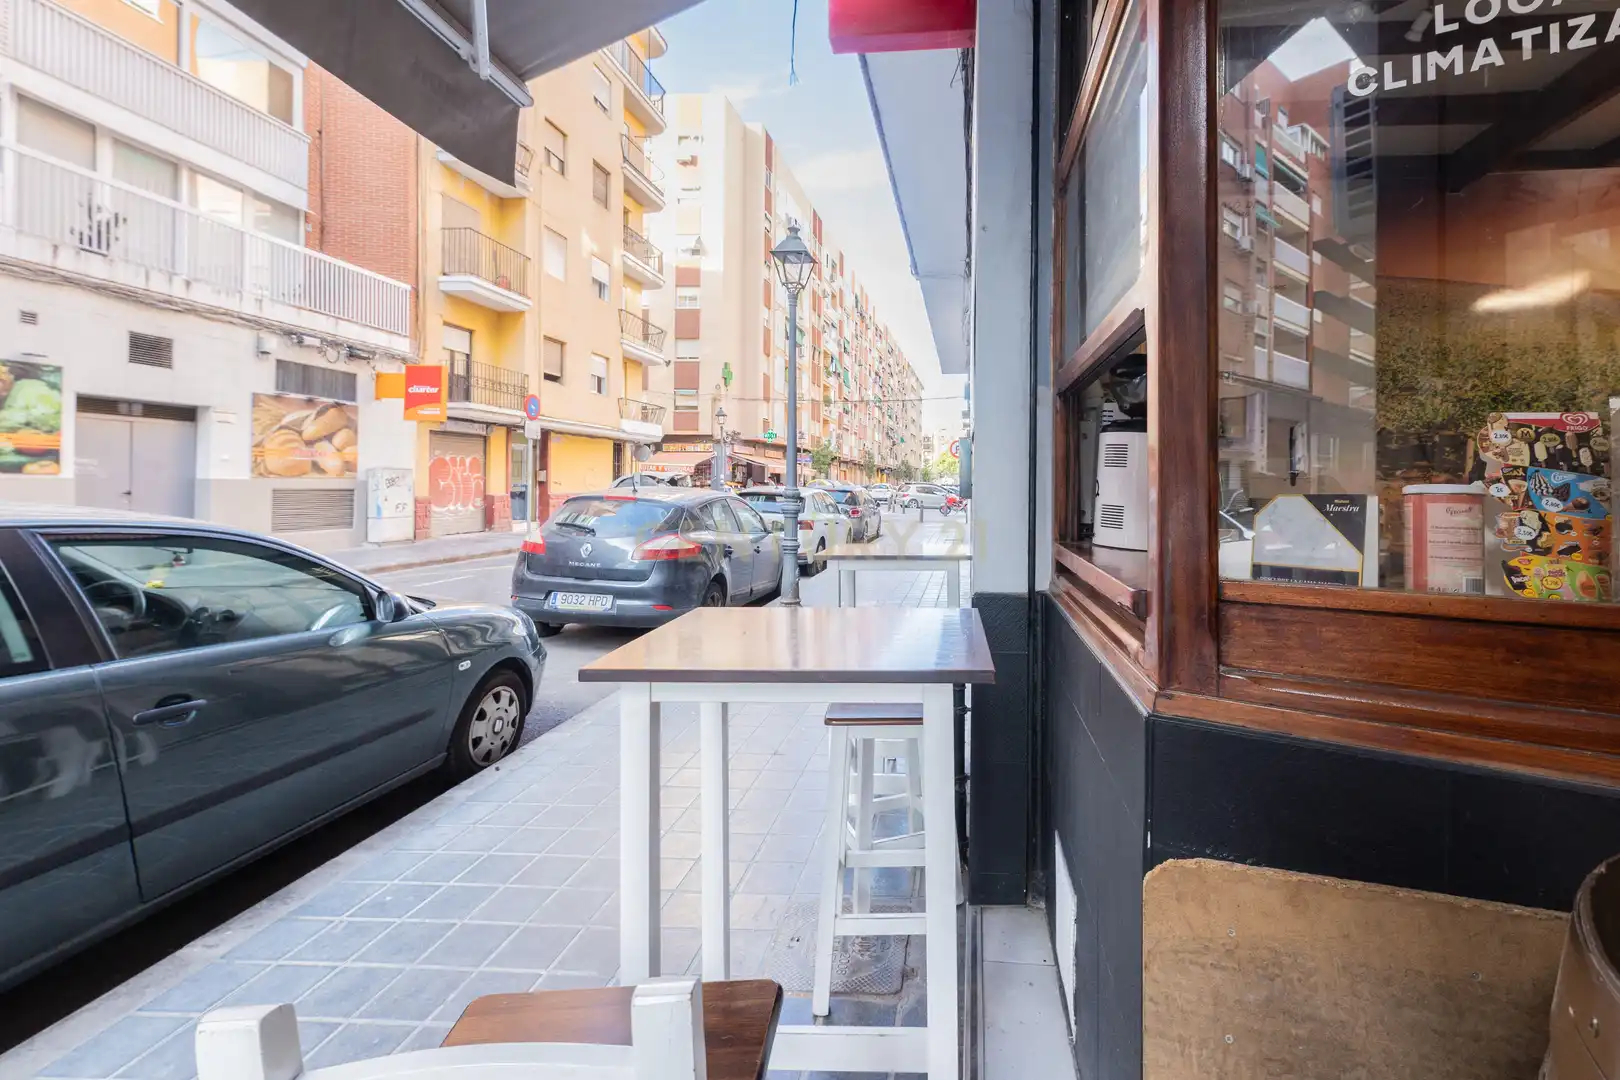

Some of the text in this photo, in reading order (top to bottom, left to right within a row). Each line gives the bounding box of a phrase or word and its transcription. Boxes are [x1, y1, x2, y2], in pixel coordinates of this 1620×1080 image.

[1434, 0, 1562, 35] LOC
[560, 593, 608, 607] 9032 HPD
